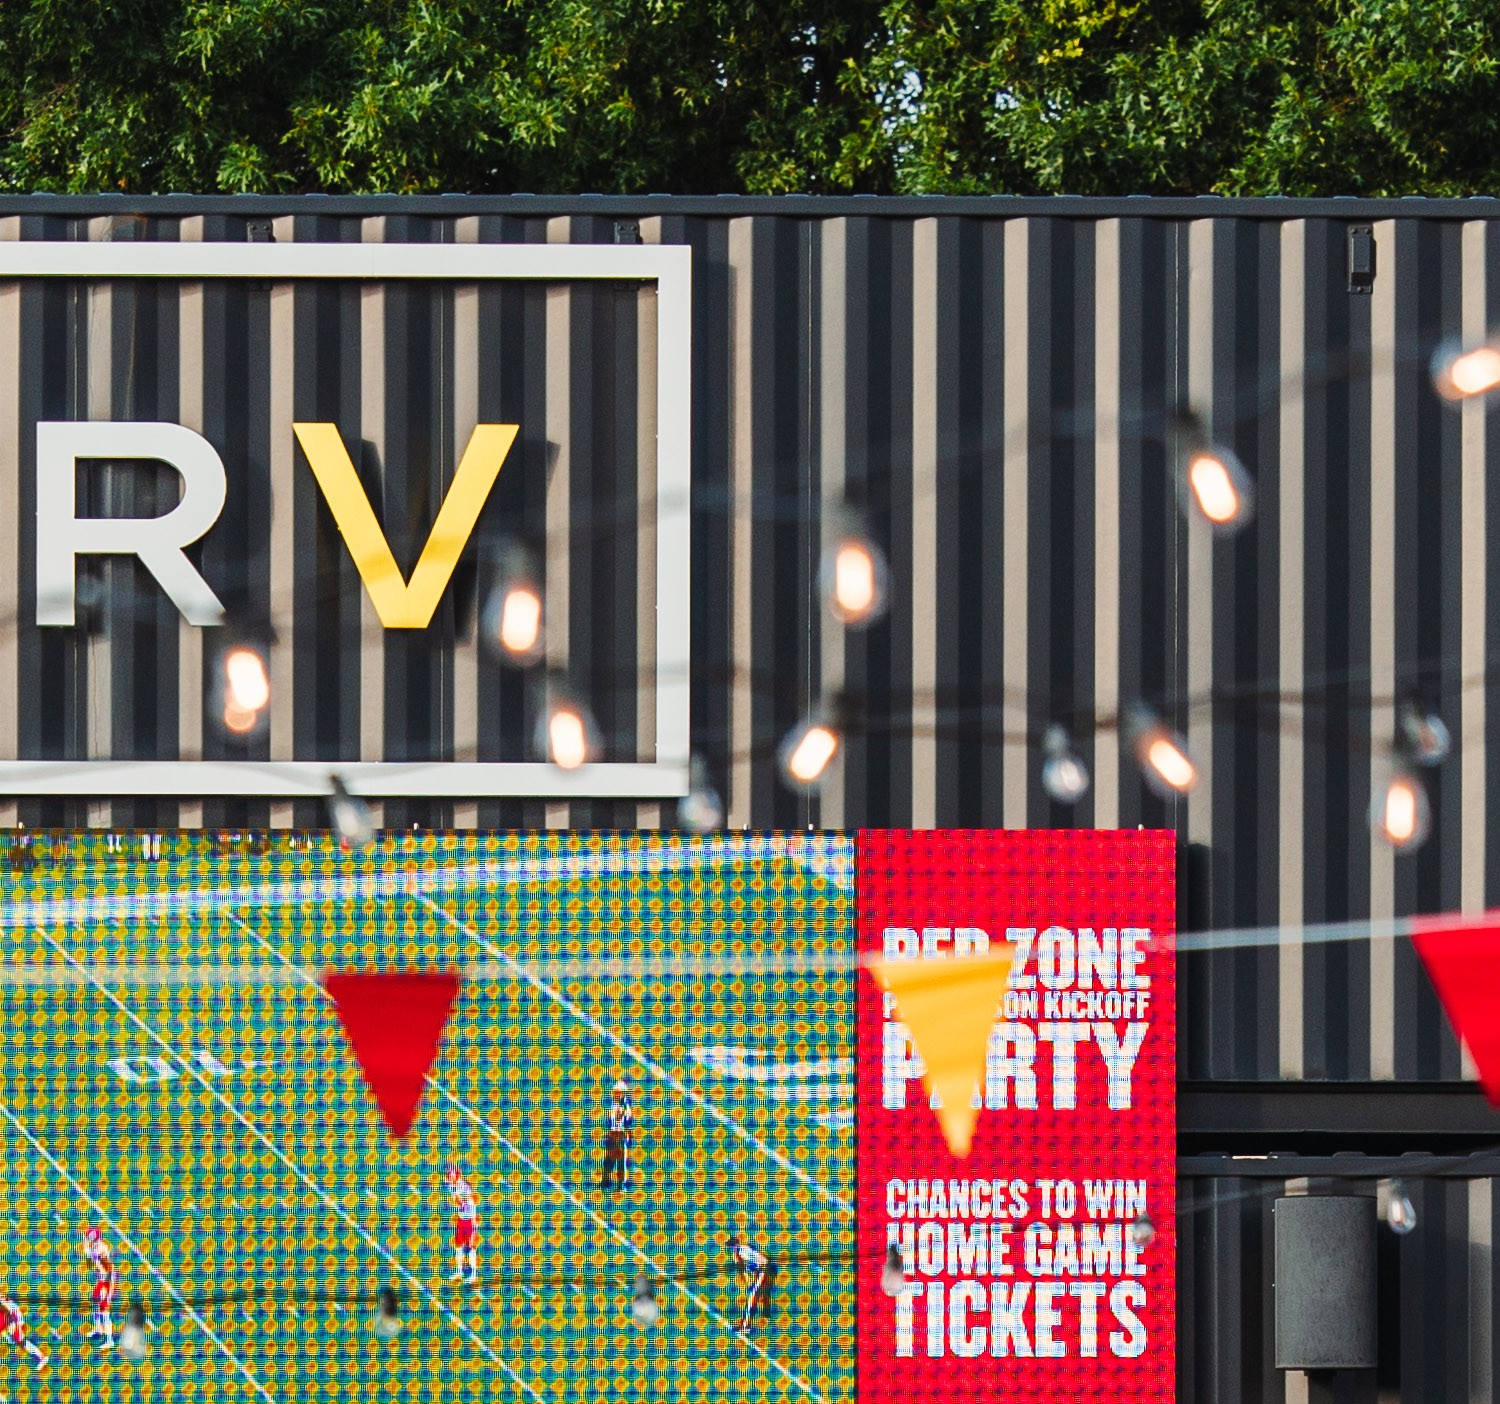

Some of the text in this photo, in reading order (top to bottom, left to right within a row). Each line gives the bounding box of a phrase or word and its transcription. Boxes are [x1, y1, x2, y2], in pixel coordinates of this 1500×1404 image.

[1004, 927, 1151, 989] ZONE
[1043, 991, 1150, 1019] KICKOFF
[886, 1179, 1147, 1219] CHANCES TO WIN
[887, 1222, 1147, 1277] HOME GAME
[894, 1280, 1147, 1357] TICKETS
